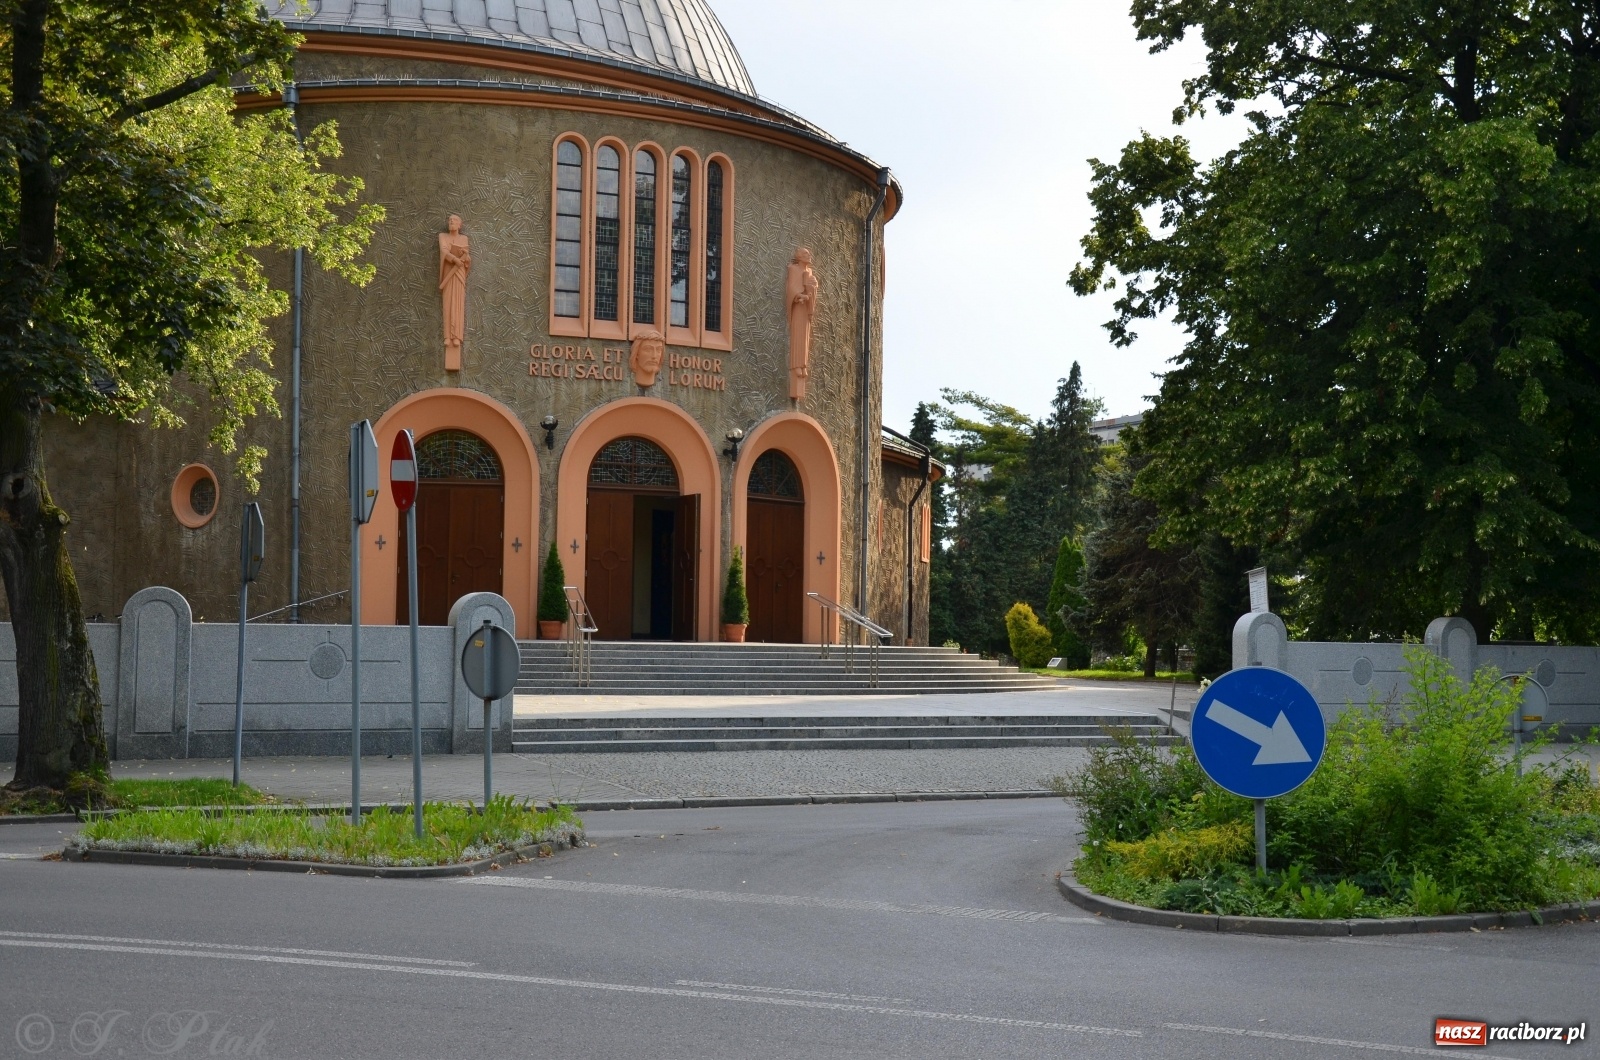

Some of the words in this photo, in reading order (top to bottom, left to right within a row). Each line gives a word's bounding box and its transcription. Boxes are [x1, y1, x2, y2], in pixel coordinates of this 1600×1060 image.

[530, 343, 596, 361] GLORIA
[603, 347, 624, 364] ET
[669, 353, 723, 373] HONOR
[529, 361, 569, 378] REGI
[669, 370, 726, 391] LORUM
